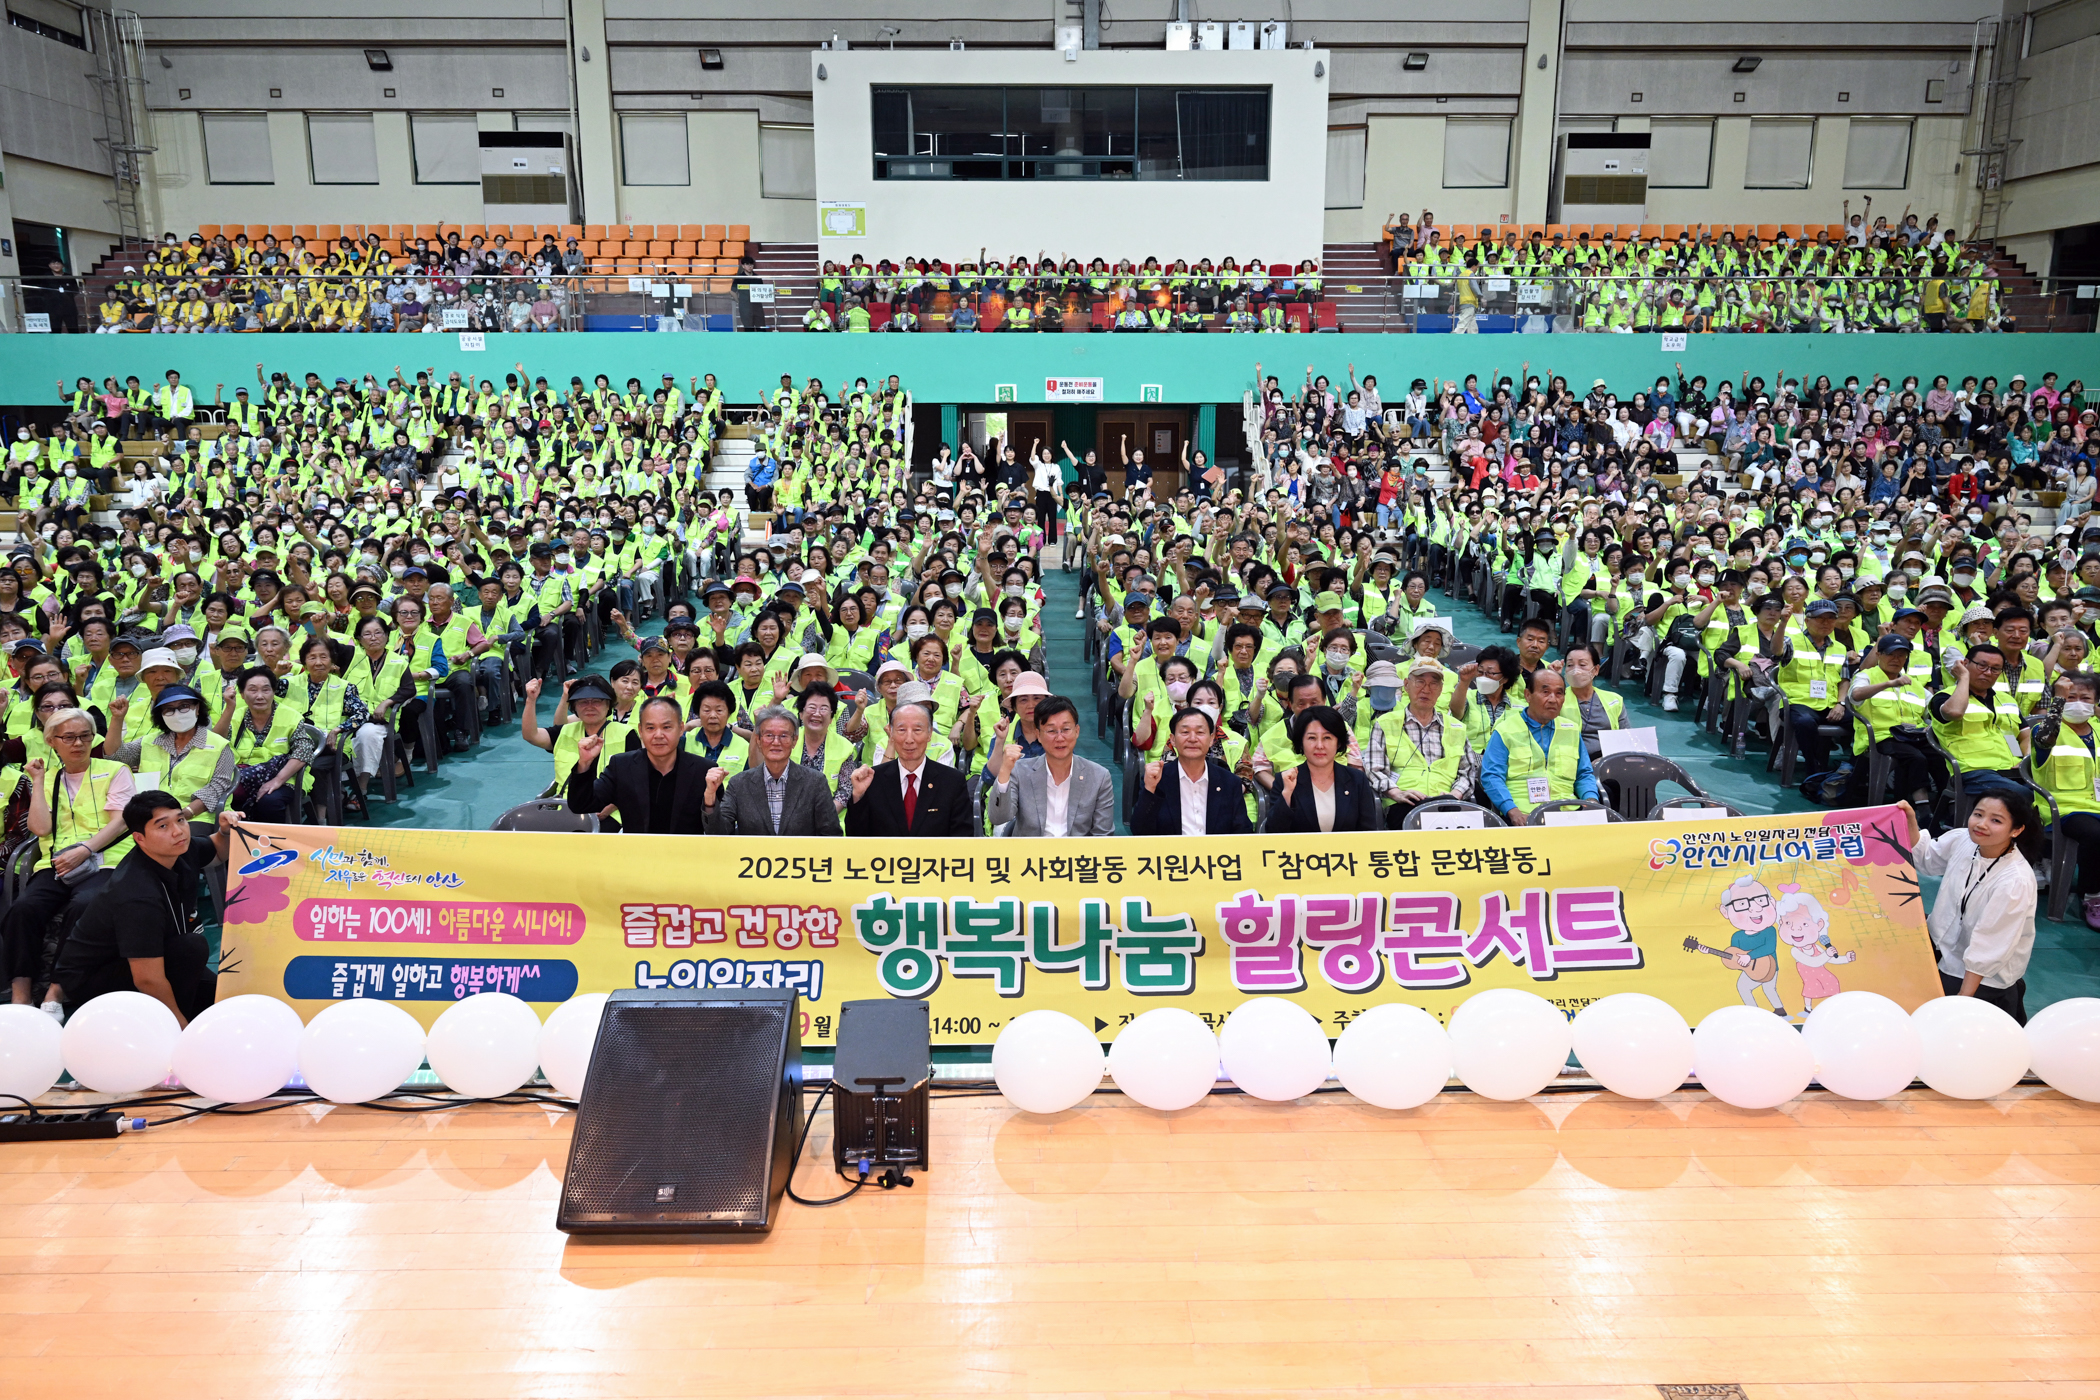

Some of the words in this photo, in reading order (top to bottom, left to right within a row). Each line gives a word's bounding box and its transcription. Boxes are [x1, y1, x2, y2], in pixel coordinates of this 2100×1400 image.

[1681, 834, 1866, 869] 안산시니어클럽
[1682, 831, 1726, 846] 안산시
[1729, 828, 1800, 843] 노인일자리
[1803, 823, 1863, 839] 전담기관
[309, 845, 358, 871] 시민과
[737, 856, 833, 883] 2025년
[843, 856, 975, 885] 노인일자리
[985, 856, 1012, 885] 및
[1020, 854, 1127, 884] 사회활동
[1137, 853, 1243, 882] 지원사업
[1262, 849, 1358, 880] 「참여자
[1368, 849, 1421, 879] 통합
[1430, 846, 1551, 878] 문화활동」
[324, 869, 367, 891] 자유로운
[371, 869, 422, 890] 혁신도시
[426, 871, 465, 888] 안산
[309, 904, 361, 940] 일하는
[368, 906, 432, 936] 100세!
[438, 907, 506, 942] 아름다운
[512, 909, 573, 938] 시니어!
[621, 903, 727, 948] 즐겁고
[727, 904, 842, 950] 건강한
[854, 893, 1201, 996] 행복나눔
[1218, 887, 1638, 990] 힐링콘서트
[331, 962, 386, 998] 즐겁게
[391, 962, 443, 998] 일하고
[932, 1016, 981, 1035] 14:00
